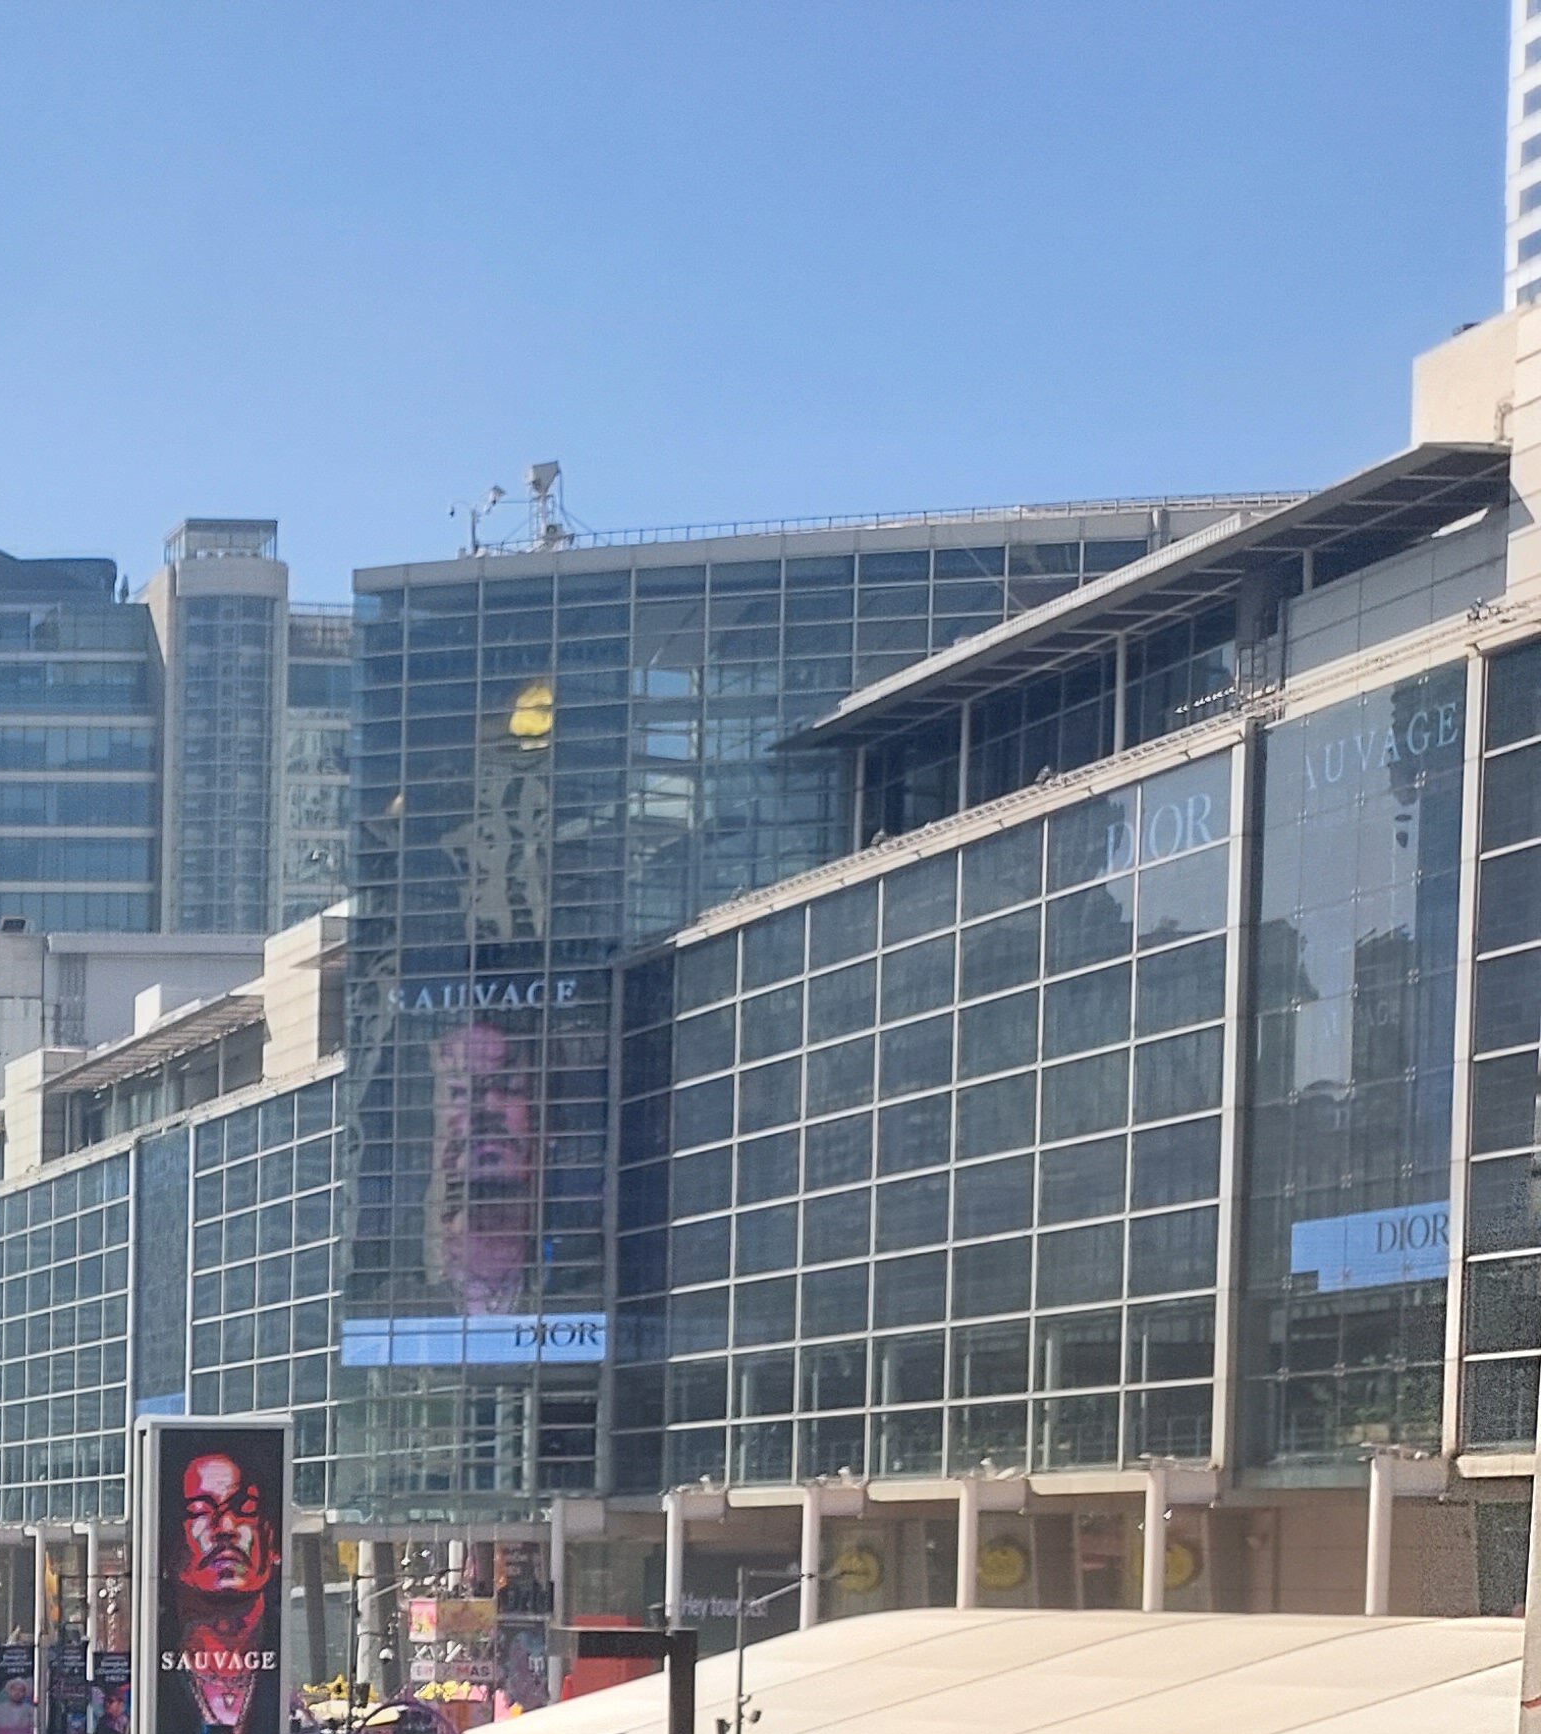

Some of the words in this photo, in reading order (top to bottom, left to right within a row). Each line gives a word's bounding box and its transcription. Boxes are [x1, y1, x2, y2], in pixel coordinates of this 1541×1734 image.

[1106, 792, 1214, 874] DOR
[1377, 1214, 1450, 1254] DIOR
[514, 1321, 600, 1348] DIOR
[161, 1650, 278, 1671] SAUVAGE
